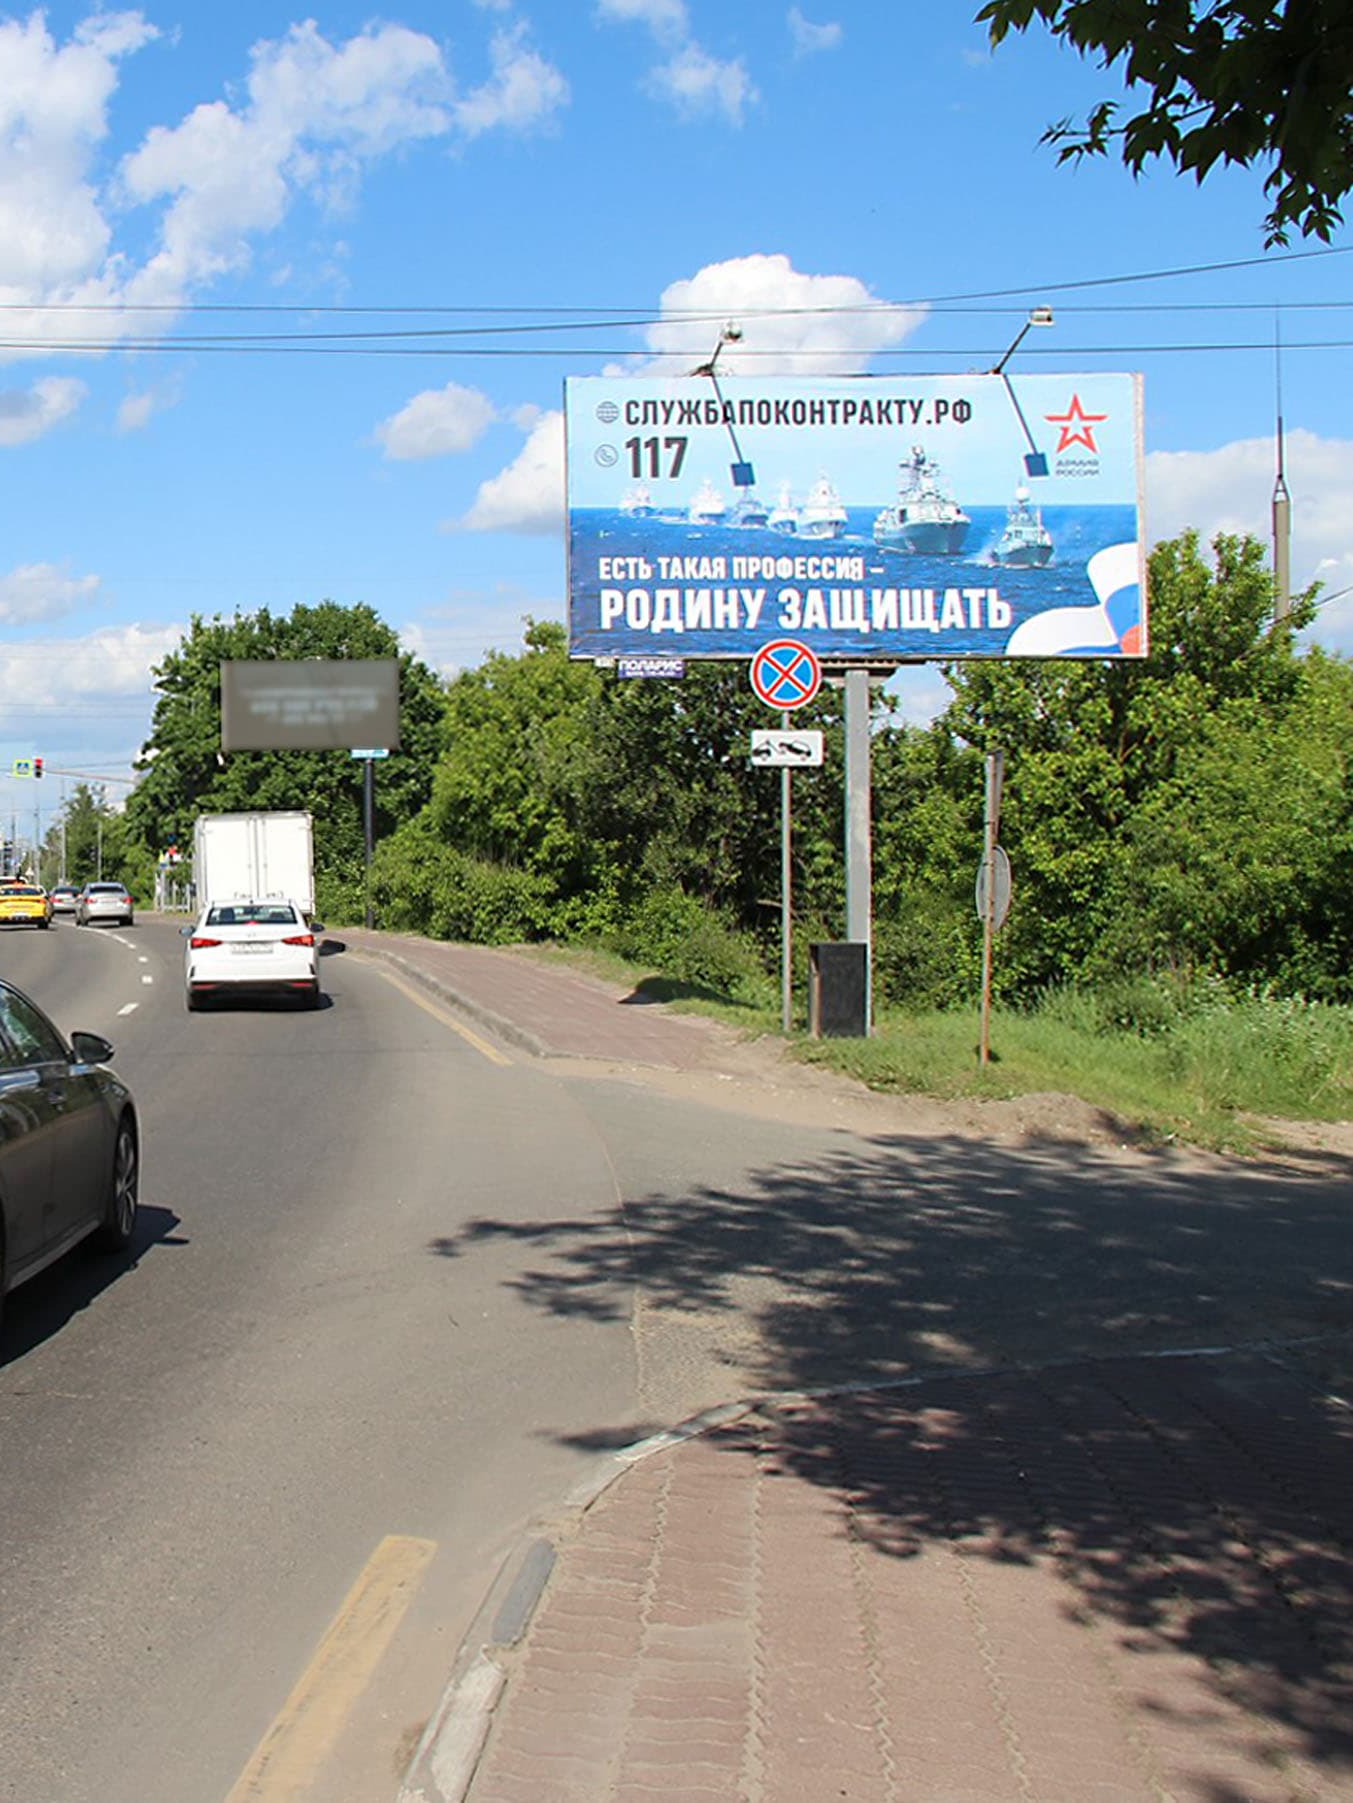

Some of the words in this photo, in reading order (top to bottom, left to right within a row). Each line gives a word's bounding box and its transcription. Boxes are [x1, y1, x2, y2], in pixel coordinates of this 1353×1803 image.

[625, 399, 972, 426] СЛУЖБАПОКОНТРАКТУ.РФ
[625, 436, 689, 479] 117
[599, 556, 652, 580] ЕСТЬ
[657, 556, 726, 580] ТАКАЯ
[732, 556, 865, 581] ПРОФЕССИЯ
[600, 588, 767, 634] РОДИНУ
[778, 588, 1012, 634] ЗАЩИЩАТЬ
